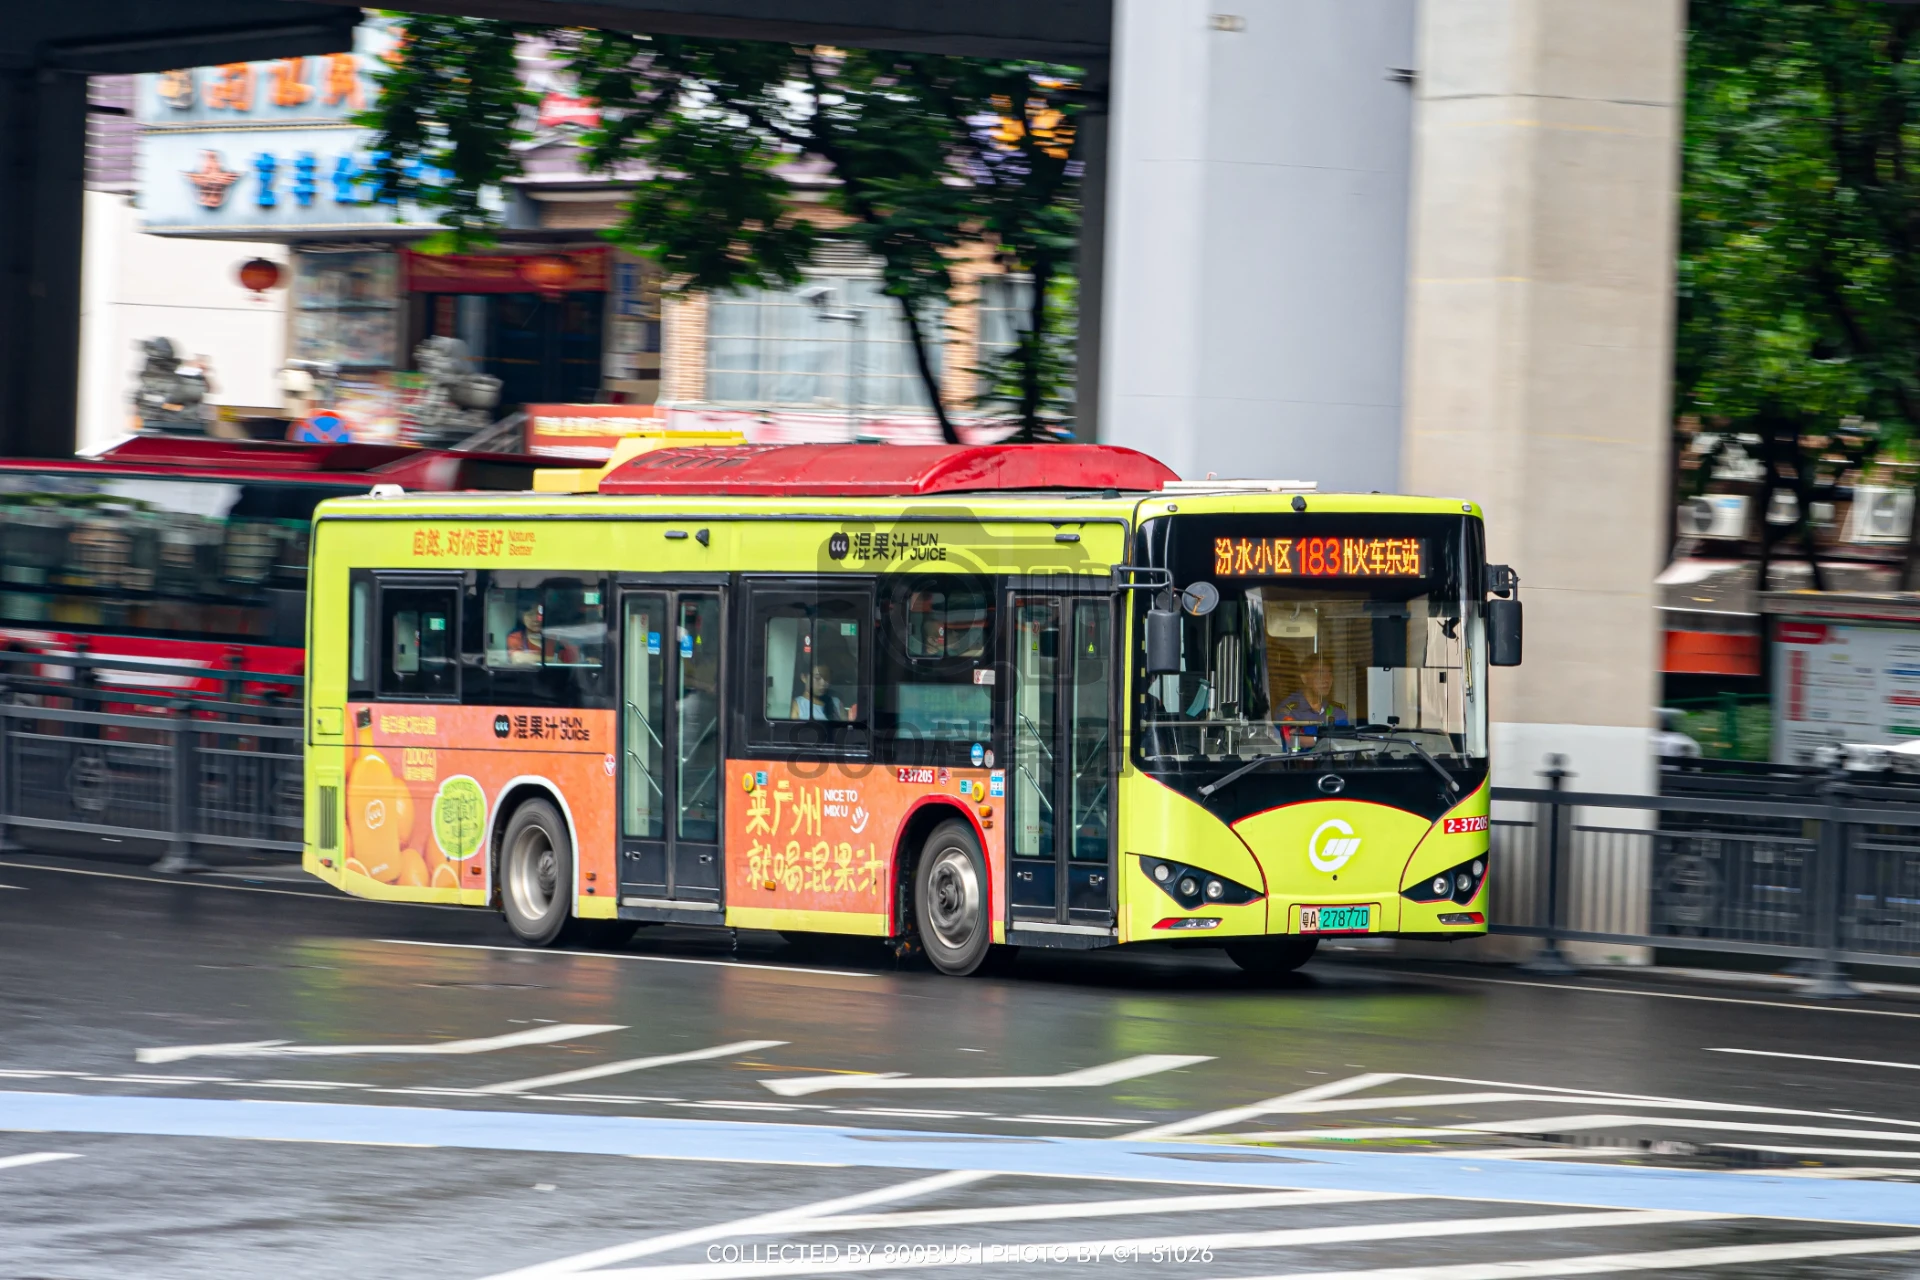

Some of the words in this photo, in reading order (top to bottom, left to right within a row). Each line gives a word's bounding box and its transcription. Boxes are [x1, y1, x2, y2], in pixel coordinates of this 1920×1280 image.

[911, 532, 939, 546] HUN
[853, 532, 909, 561] 混果汁
[910, 547, 947, 561] JUICE
[1215, 538, 1292, 575] 汾水小区
[1296, 537, 1342, 575] 183
[513, 714, 558, 740] 混果汁
[560, 716, 583, 729] HUN
[559, 728, 590, 741] JUICE
[898, 769, 933, 783] 2-37205
[823, 789, 846, 802] NICE
[845, 789, 858, 803] TO
[745, 780, 822, 837] 来广州
[823, 804, 841, 817] MIX
[840, 805, 849, 818] U
[1447, 816, 1488, 833] 2-37205
[746, 838, 884, 896] 就喝混果汁
